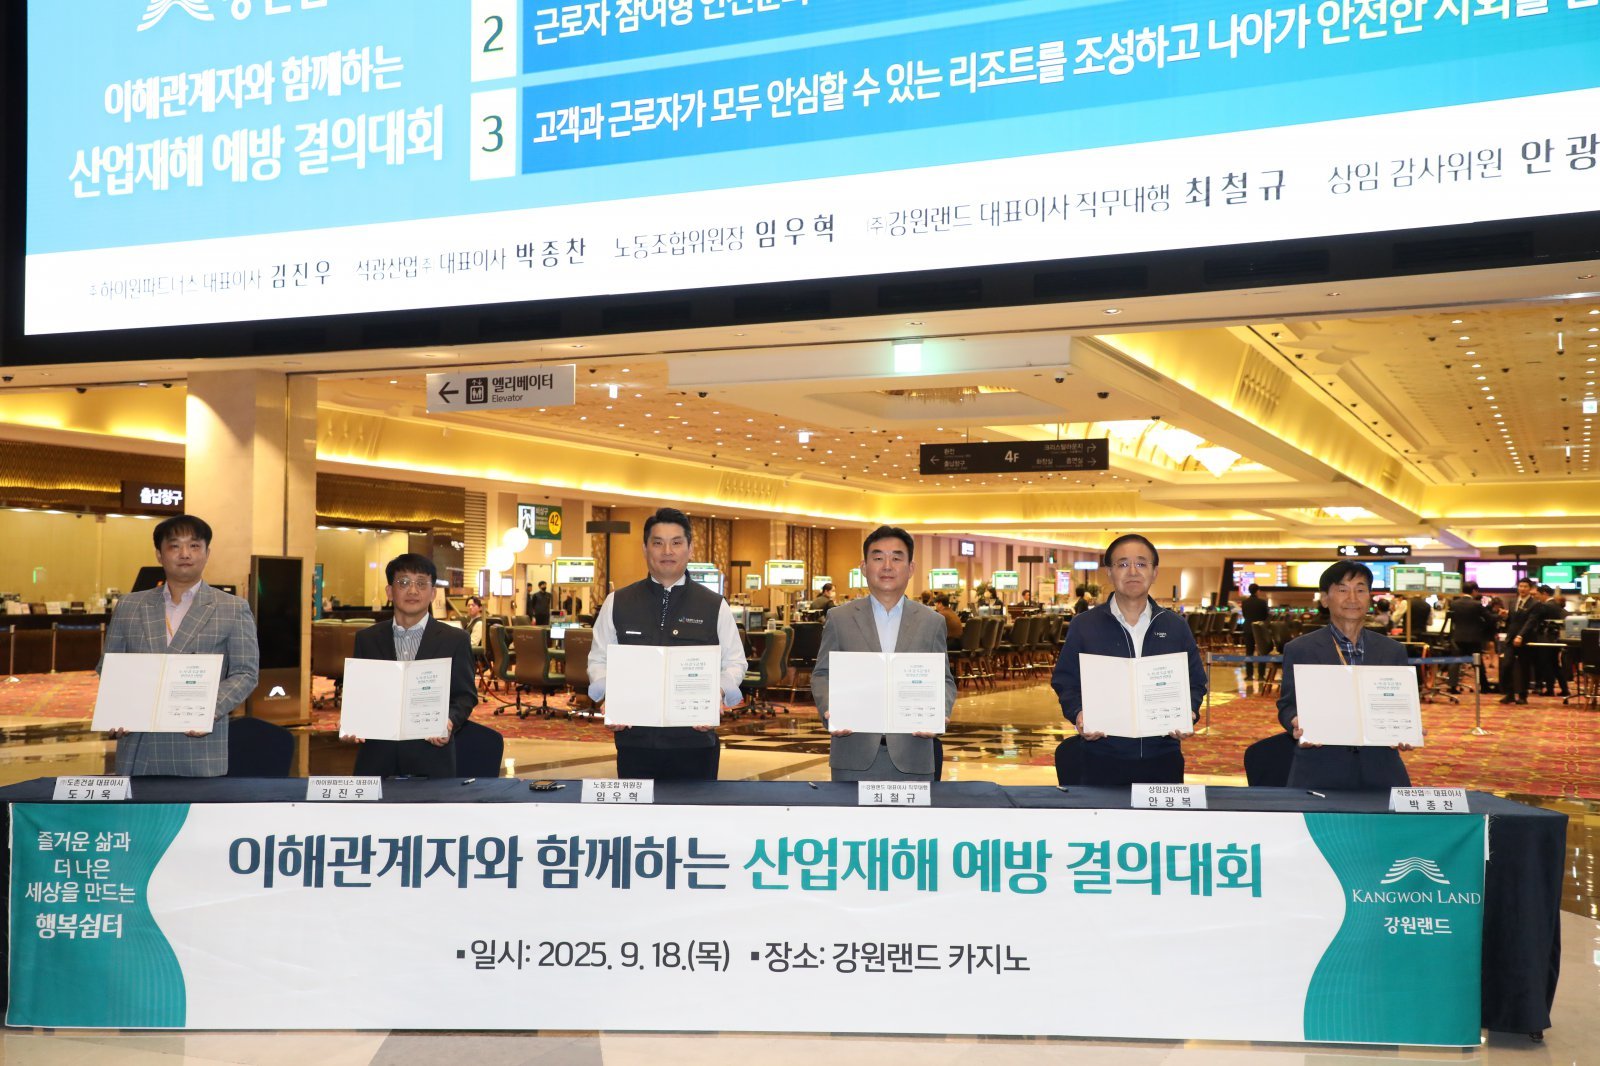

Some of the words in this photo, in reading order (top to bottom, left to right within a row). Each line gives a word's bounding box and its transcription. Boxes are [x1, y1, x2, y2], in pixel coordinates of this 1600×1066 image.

[483, 15, 504, 53] 2
[534, 4, 611, 46] 근로자
[104, 60, 275, 123] 이해관계자와
[281, 45, 404, 100] 함께하는
[533, 104, 605, 145] 고객과
[608, 89, 706, 138] 근로자가
[712, 83, 763, 123] 모두
[767, 69, 847, 119] 안심할
[851, 67, 881, 107] 수
[886, 59, 942, 104] 있는
[949, 40, 1068, 95] 리조트를
[1073, 23, 1201, 76] 조성하고
[1207, 4, 1311, 58] 나아가
[1317, 0, 1424, 45] 안전한
[481, 114, 504, 152] 3
[68, 134, 204, 199] 산업재해
[211, 124, 285, 183] 예방
[294, 103, 444, 175] 결의대회
[203, 268, 262, 294] 대표이사
[439, 247, 506, 275] 대표이사
[614, 226, 745, 260] 노동조합위원장
[979, 193, 1070, 228] 대표이사
[1076, 183, 1170, 219] 직무대행
[1328, 160, 1379, 195] 상임
[1390, 146, 1503, 188] 감사위원
[491, 373, 553, 392] 엘리베이터
[491, 394, 524, 403] Elevator
[1004, 450, 1020, 463] 4F
[140, 487, 183, 506] 출납창구
[550, 514, 559, 526] 42
[593, 781, 620, 789] 노동조합
[622, 781, 642, 789] 위원장
[37, 831, 90, 852] 즐거운
[94, 831, 131, 852] 삶과
[54, 858, 71, 879] 더
[75, 858, 110, 880] 나은
[228, 834, 523, 889] 이해관계자와
[536, 833, 730, 890] 함께하는
[743, 836, 939, 892] 산업재해
[952, 838, 1053, 895] 예방
[1065, 839, 1263, 899] 결의대회
[25, 881, 80, 904] 세상을
[84, 882, 136, 904] 만드는
[1352, 889, 1433, 903] KANGWON
[1437, 890, 1481, 905] LAND
[35, 912, 123, 939] 행복쉼터
[1384, 916, 1453, 935] 강원랜드
[470, 940, 531, 971] 일시:
[538, 941, 613, 970] 2025.
[620, 941, 645, 970] 9.
[764, 941, 826, 974] 장소:
[831, 941, 942, 974] 강원랜드
[947, 942, 1031, 976] 카지노
